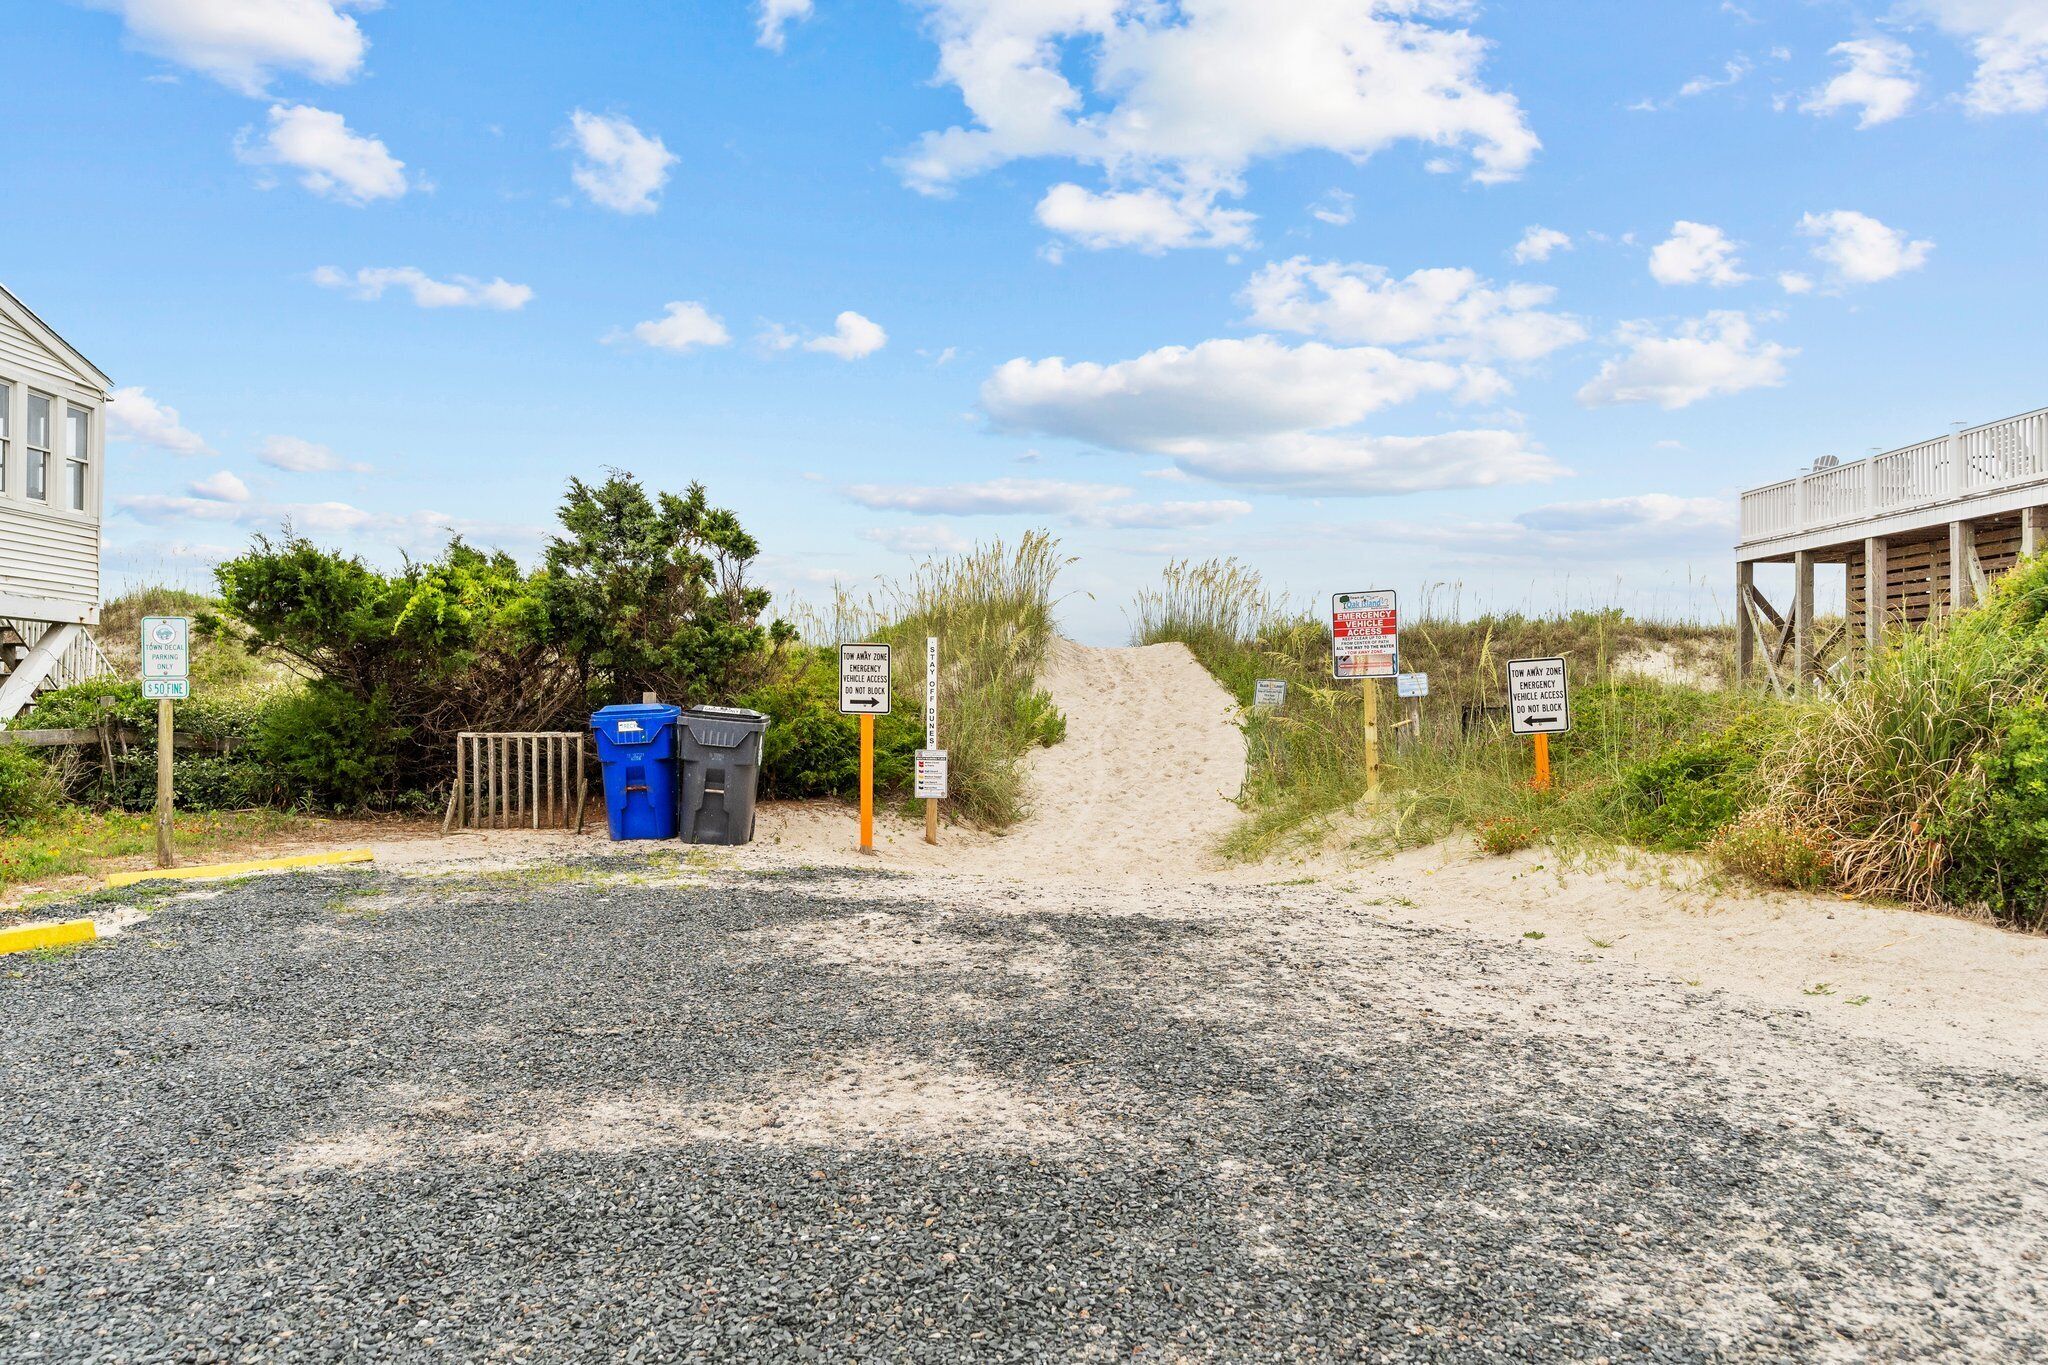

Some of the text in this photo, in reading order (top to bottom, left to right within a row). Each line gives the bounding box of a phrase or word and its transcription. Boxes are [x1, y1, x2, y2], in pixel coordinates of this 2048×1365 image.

[1362, 600, 1380, 608] Island
[1337, 611, 1391, 620] EMERGENCY
[1527, 668, 1543, 676] AWAY
[1546, 667, 1562, 675] ZONE
[167, 684, 183, 694] FINE
[1520, 680, 1555, 690] EMERGENCY
[1513, 691, 1563, 701] VEHICLE ACCESS
[1517, 703, 1562, 713] DO NOT BLOCK
